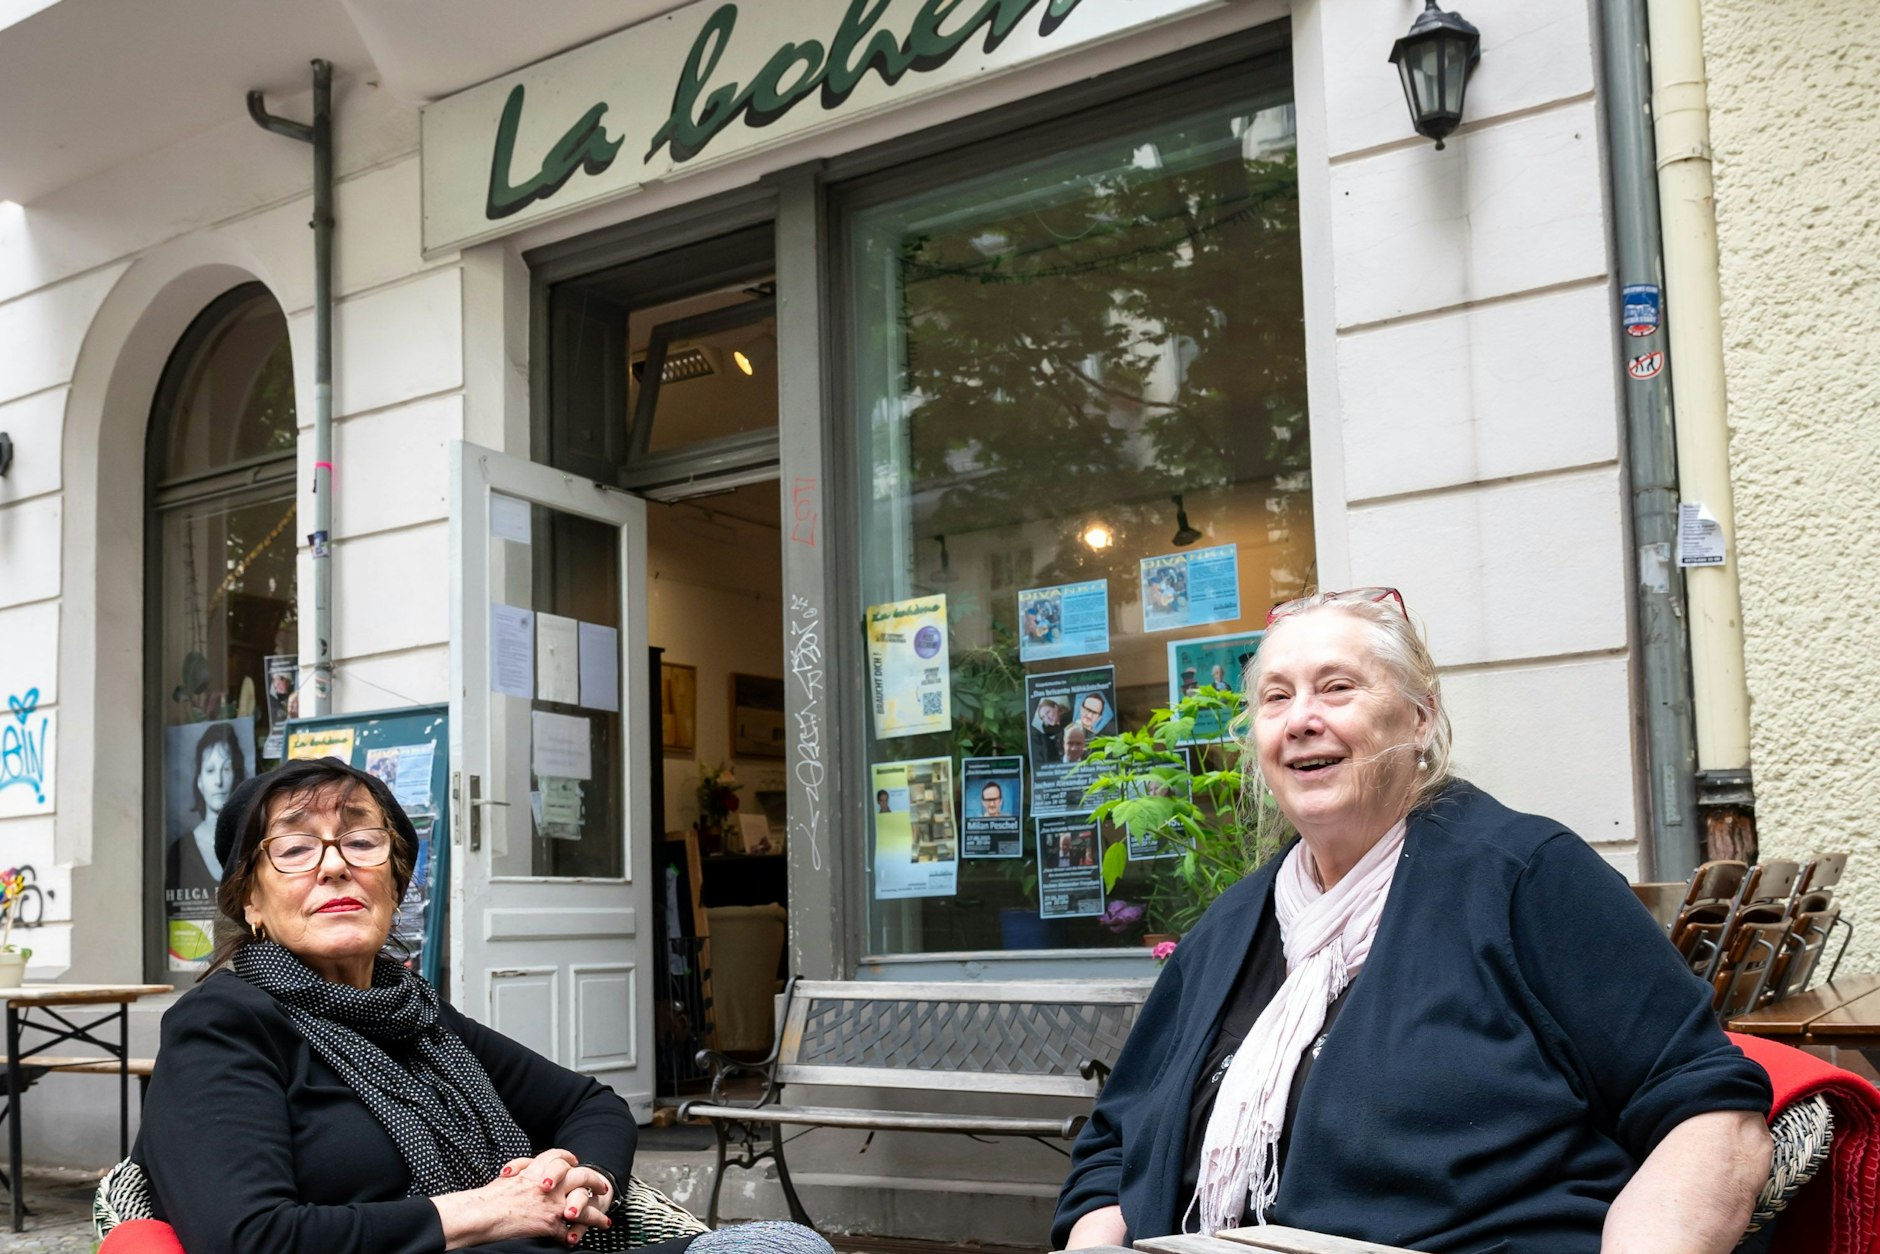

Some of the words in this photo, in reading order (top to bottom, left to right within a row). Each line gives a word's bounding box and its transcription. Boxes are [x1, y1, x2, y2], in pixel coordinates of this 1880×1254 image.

[485, 82, 626, 221] La
[873, 658, 883, 676] DICH
[967, 821, 989, 830] Milan
[990, 820, 1018, 830] Peschel
[166, 887, 209, 902] HELGA
